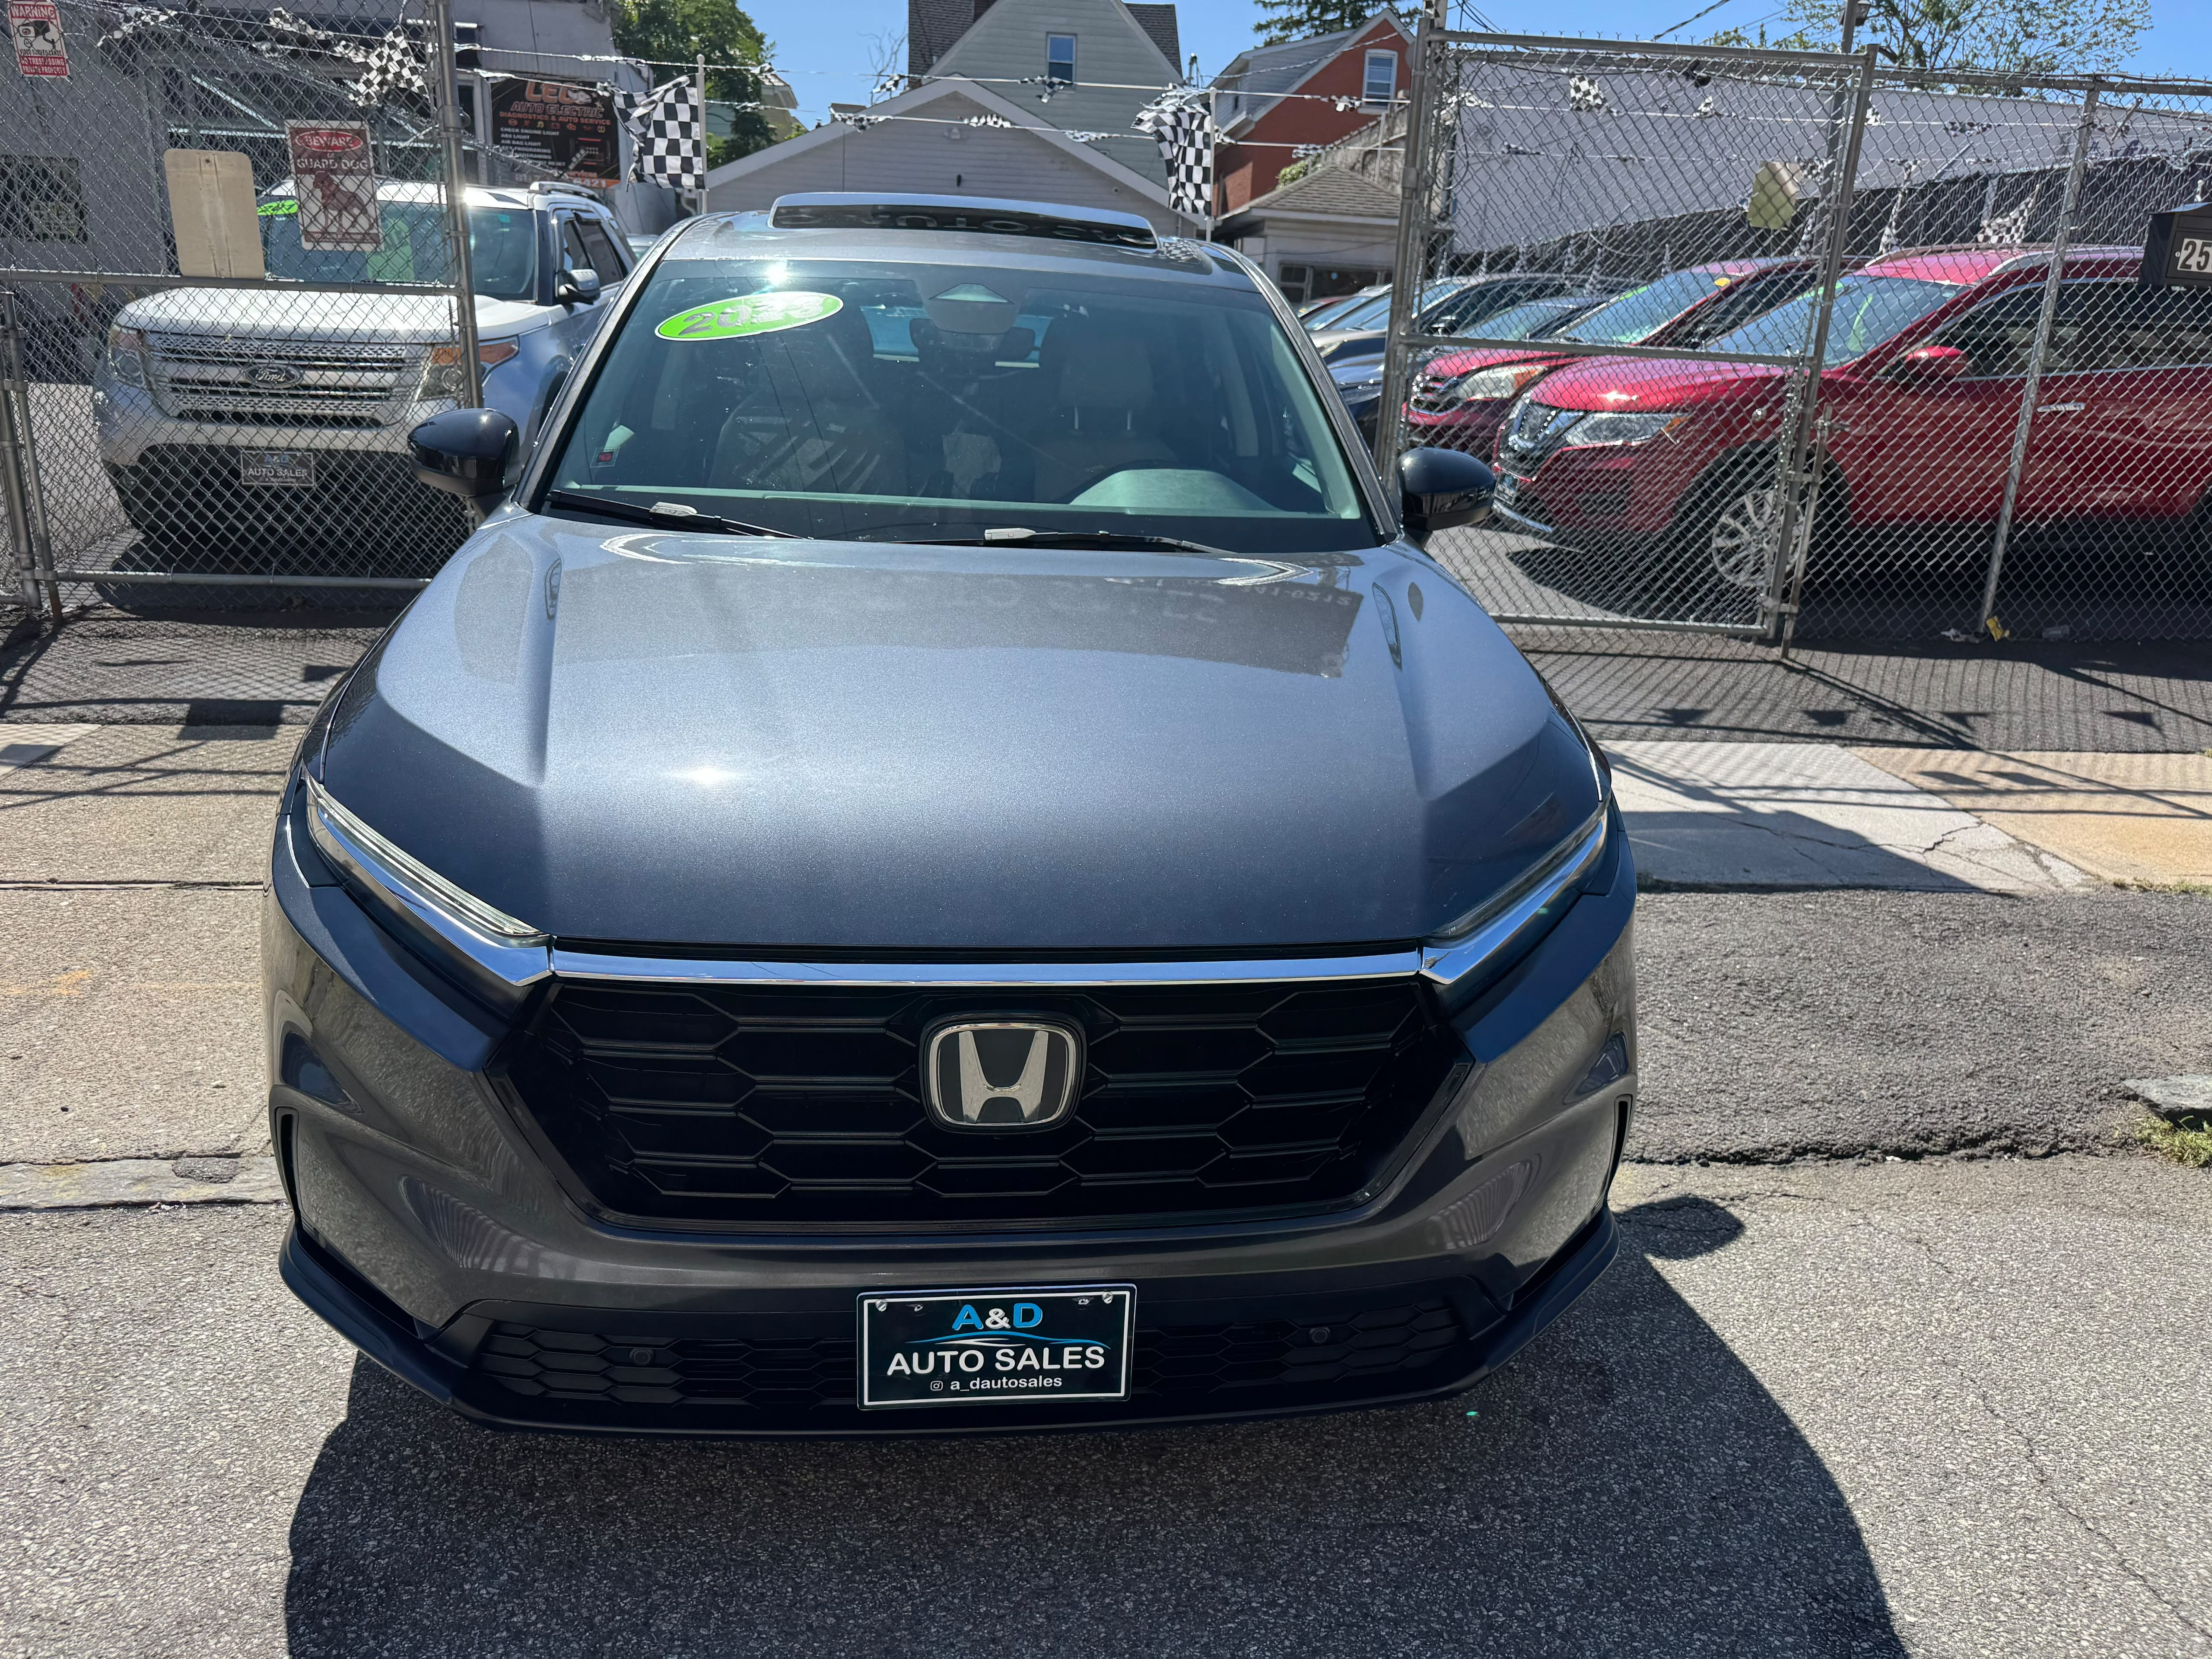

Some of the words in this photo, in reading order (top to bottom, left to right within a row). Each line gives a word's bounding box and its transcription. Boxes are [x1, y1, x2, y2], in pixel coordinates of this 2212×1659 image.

[11, 5, 55, 19] WARNING
[22, 65, 42, 73] PRIVATE
[42, 66, 66, 74] PROPERTY
[499, 111, 549, 121] DIAGNOSTICS
[510, 101, 545, 114] AUTO
[547, 104, 605, 119] ELECTRIC
[305, 135, 353, 147] BEWARE
[297, 158, 338, 169] GUARD
[341, 159, 368, 170] DOG
[2179, 240, 2212, 271] 25
[255, 368, 286, 382] Ford
[248, 468, 275, 476] AUTO
[276, 469, 308, 477] SALES
[952, 1303, 1043, 1331] A&D
[887, 1349, 984, 1376] AUTO
[995, 1346, 1105, 1370] SALES
[950, 1375, 1062, 1392] a_dautosales
